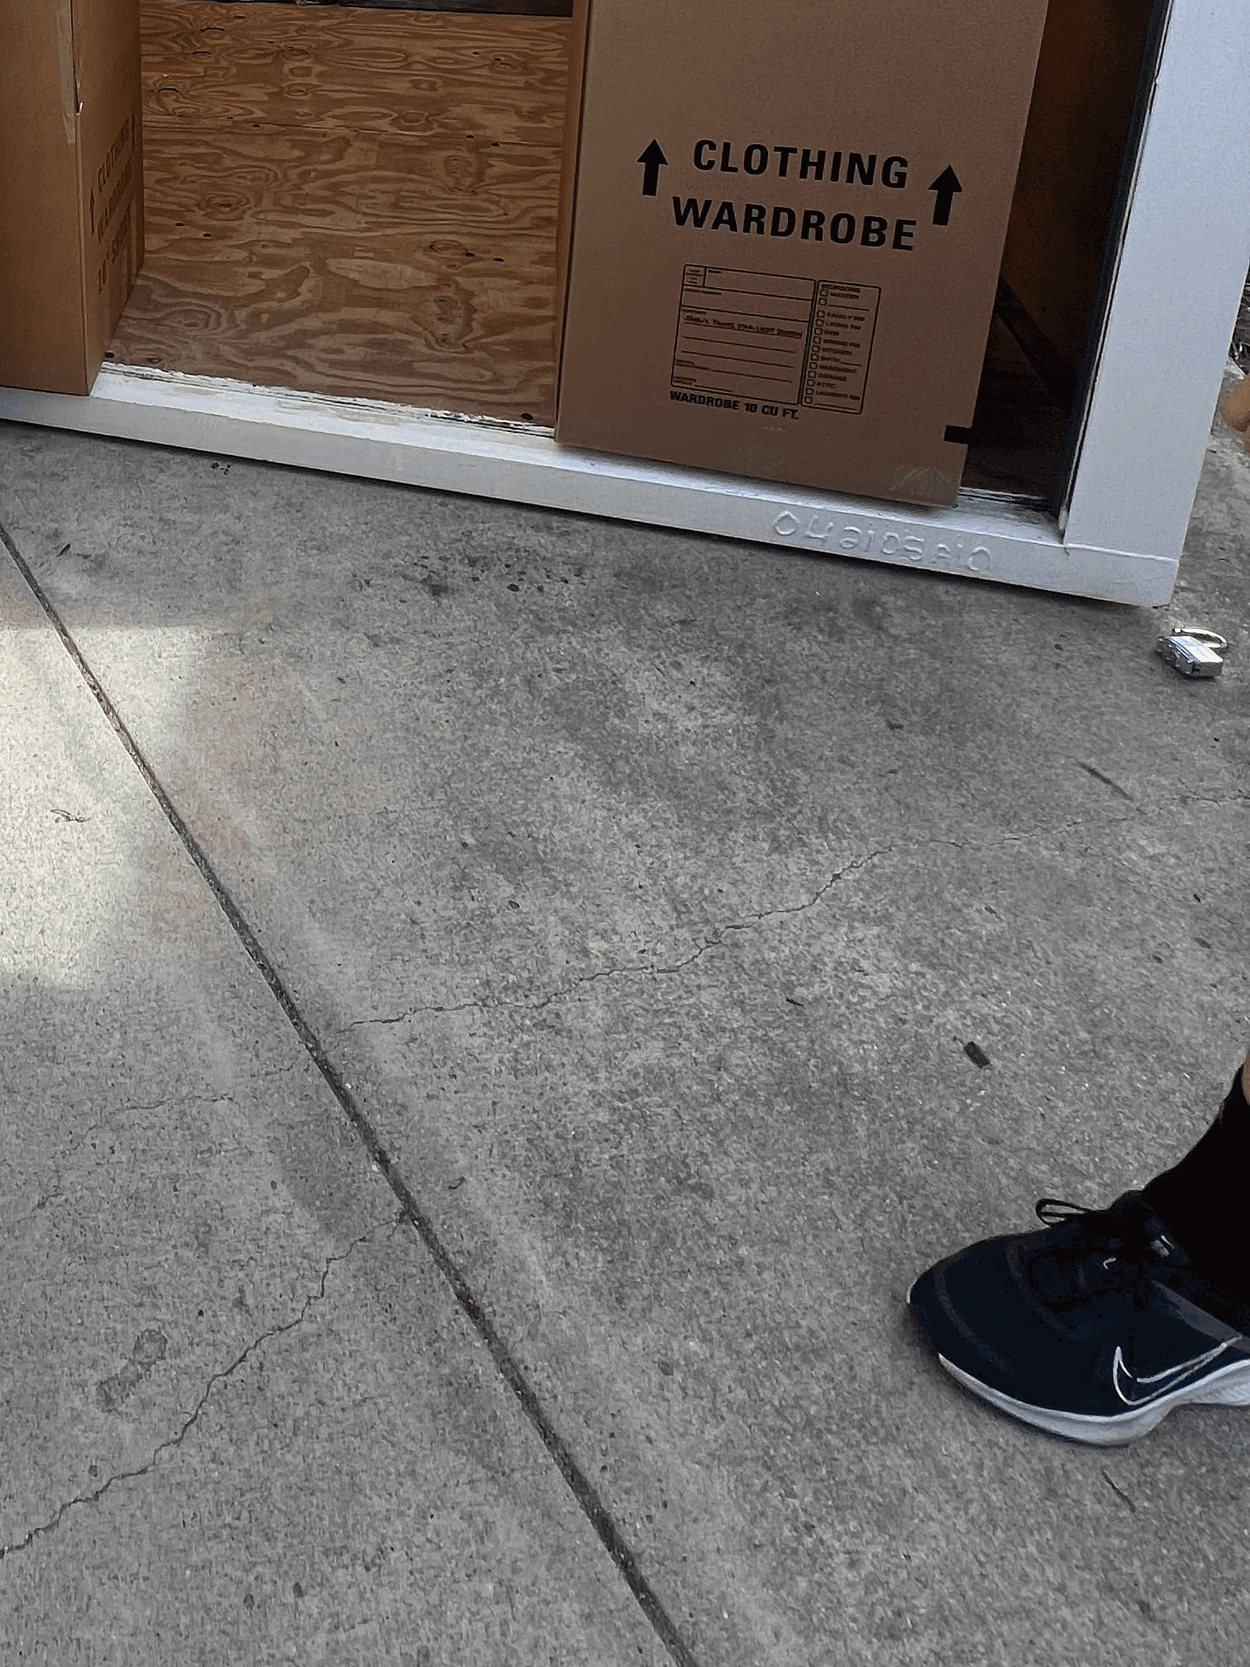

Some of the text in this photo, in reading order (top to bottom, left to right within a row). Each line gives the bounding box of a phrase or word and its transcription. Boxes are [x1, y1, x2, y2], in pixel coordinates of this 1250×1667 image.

[692, 138, 910, 190] CLOTHING
[671, 196, 918, 252] WARDROBE
[670, 390, 799, 421] WARDROBE 10 CU FT.
